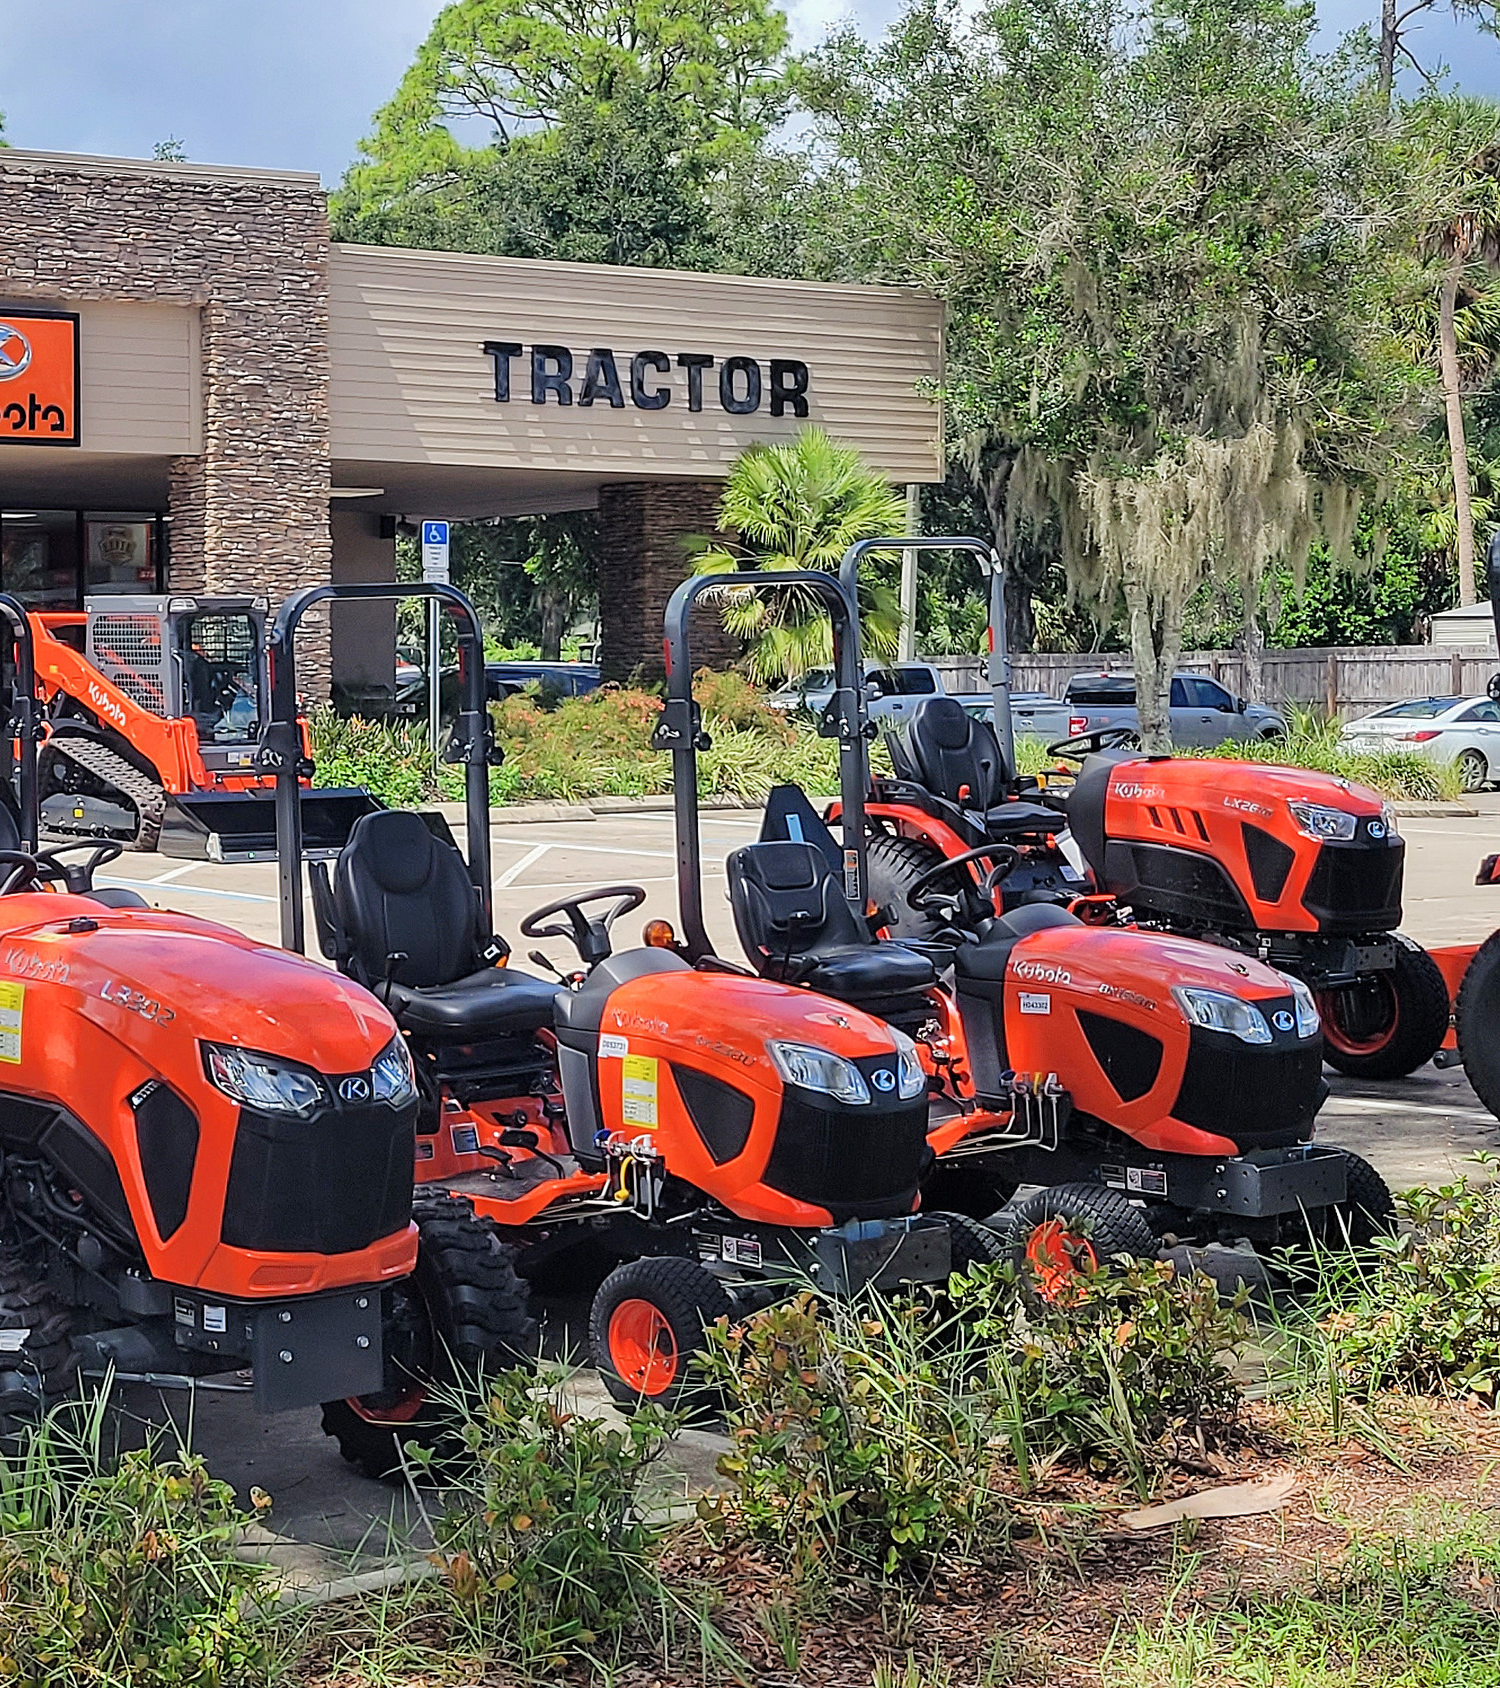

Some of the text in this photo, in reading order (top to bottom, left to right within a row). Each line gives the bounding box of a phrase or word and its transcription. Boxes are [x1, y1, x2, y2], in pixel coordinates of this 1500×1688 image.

[483, 341, 809, 418] TRACTOR
[88, 681, 126, 727] Kubota
[1114, 782, 1165, 799] Kubota
[1012, 960, 1071, 985] Kubota
[100, 980, 176, 1030] L3302
